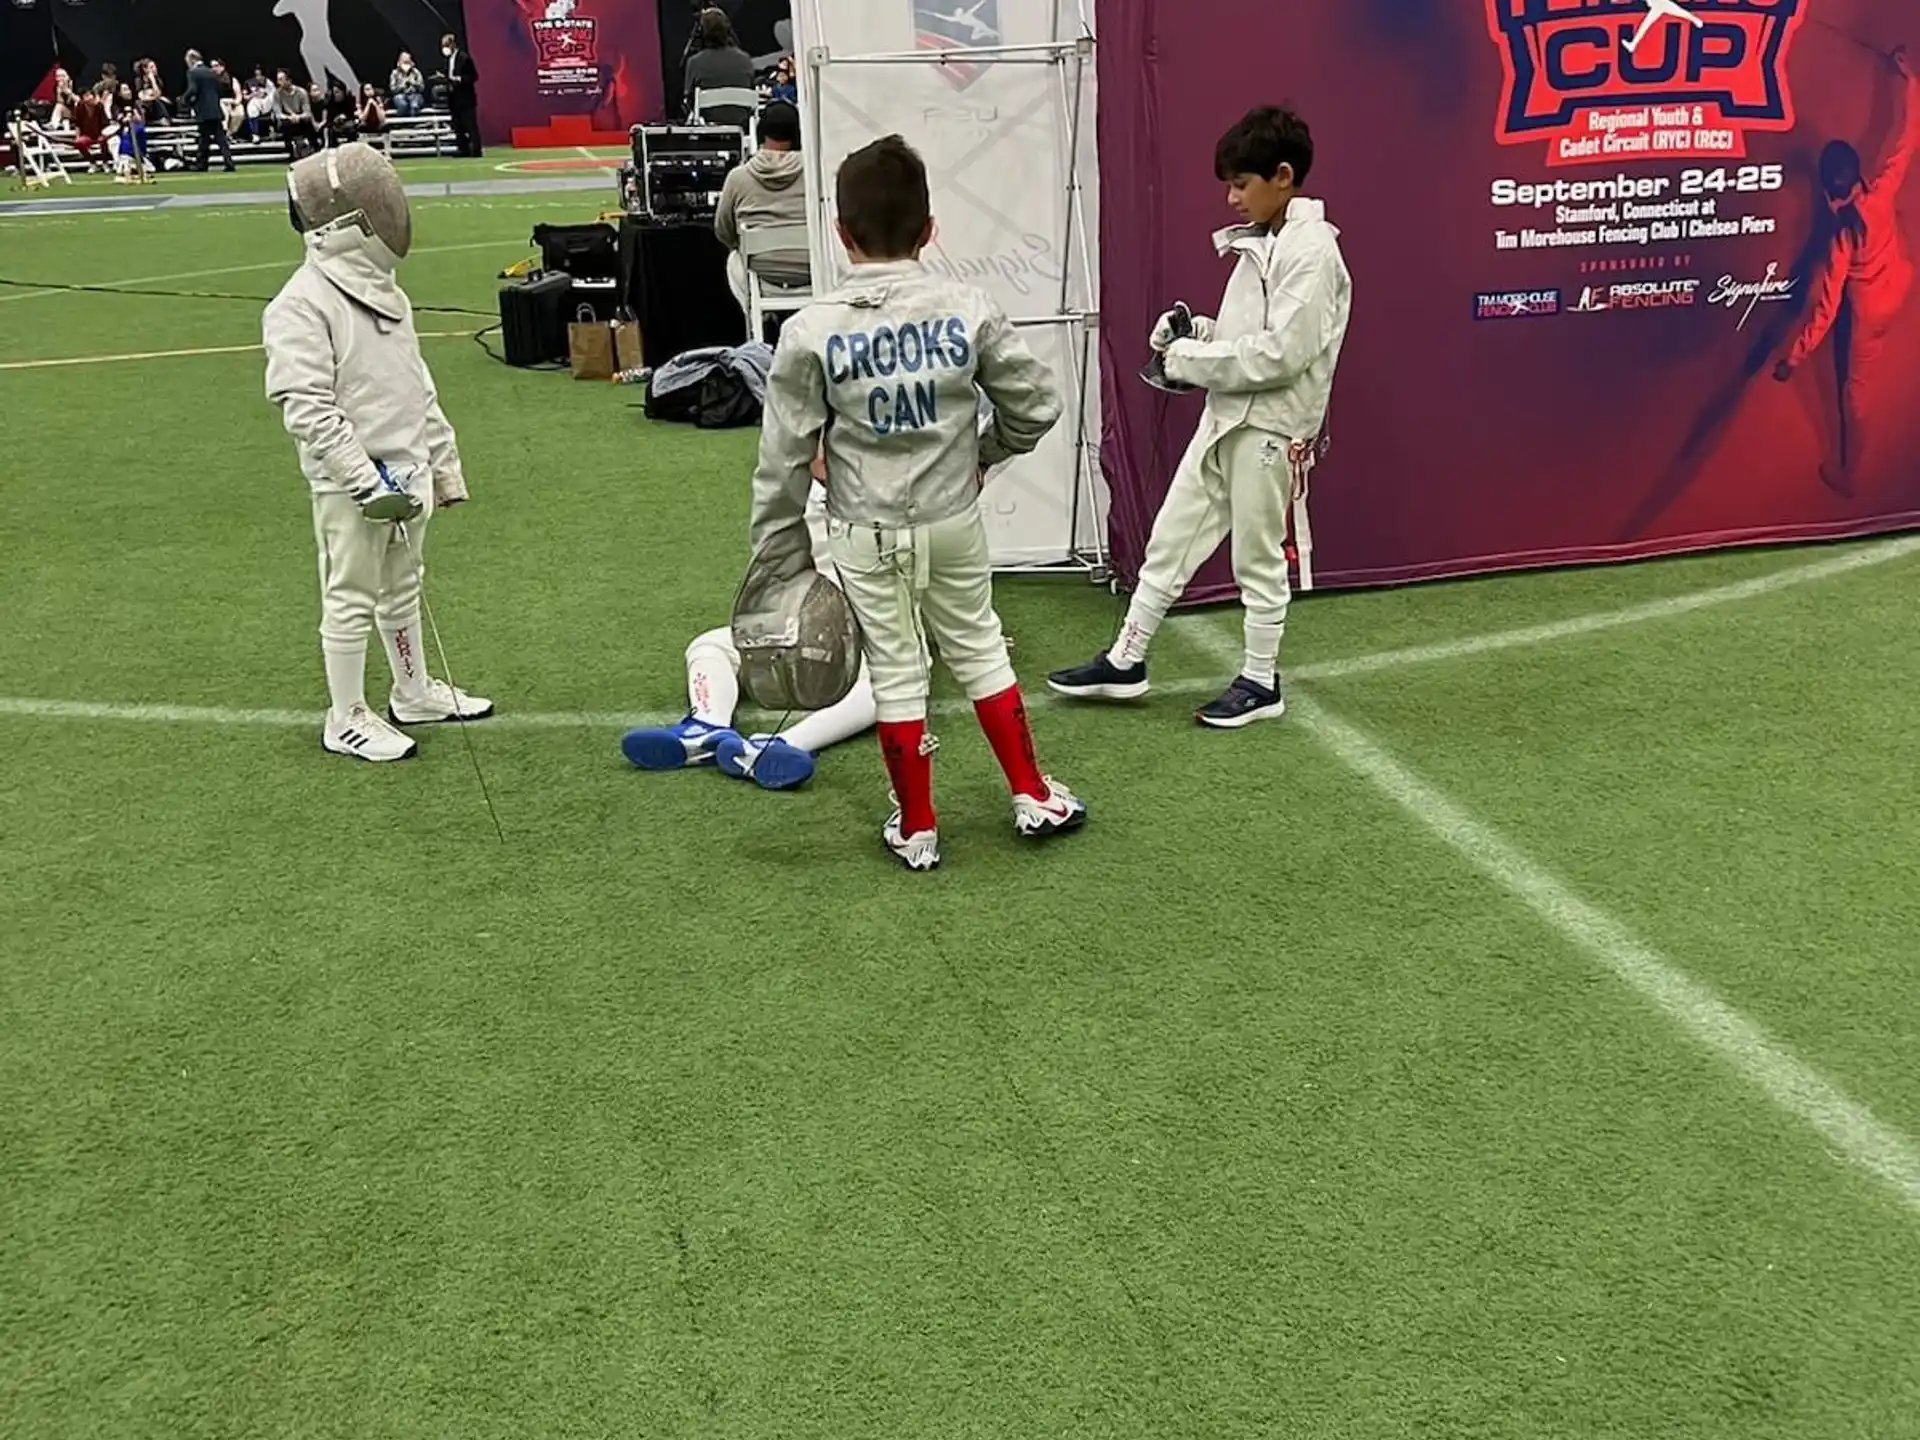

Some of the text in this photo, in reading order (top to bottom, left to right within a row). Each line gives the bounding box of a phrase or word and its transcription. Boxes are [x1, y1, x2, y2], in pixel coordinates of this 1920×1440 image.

[1545, 22, 1746, 90] CUP
[1588, 105, 1703, 132] Regional Youth &
[1560, 136, 1600, 158] Cadet
[1603, 131, 1650, 154] Circuit
[1491, 164, 1783, 208] September 24-25
[1555, 199, 1716, 224] Stamford, Connecticut at
[1495, 230, 1518, 250] Tim
[1520, 226, 1596, 248] Morehouse
[1598, 222, 1648, 245] Fencing
[1650, 218, 1679, 240] Club
[1688, 217, 1739, 237] Chelsea
[1740, 215, 1776, 234] Piers
[1609, 292, 1694, 309] FENCING
[826, 316, 971, 385] CROOKS
[867, 379, 938, 435] CAN
